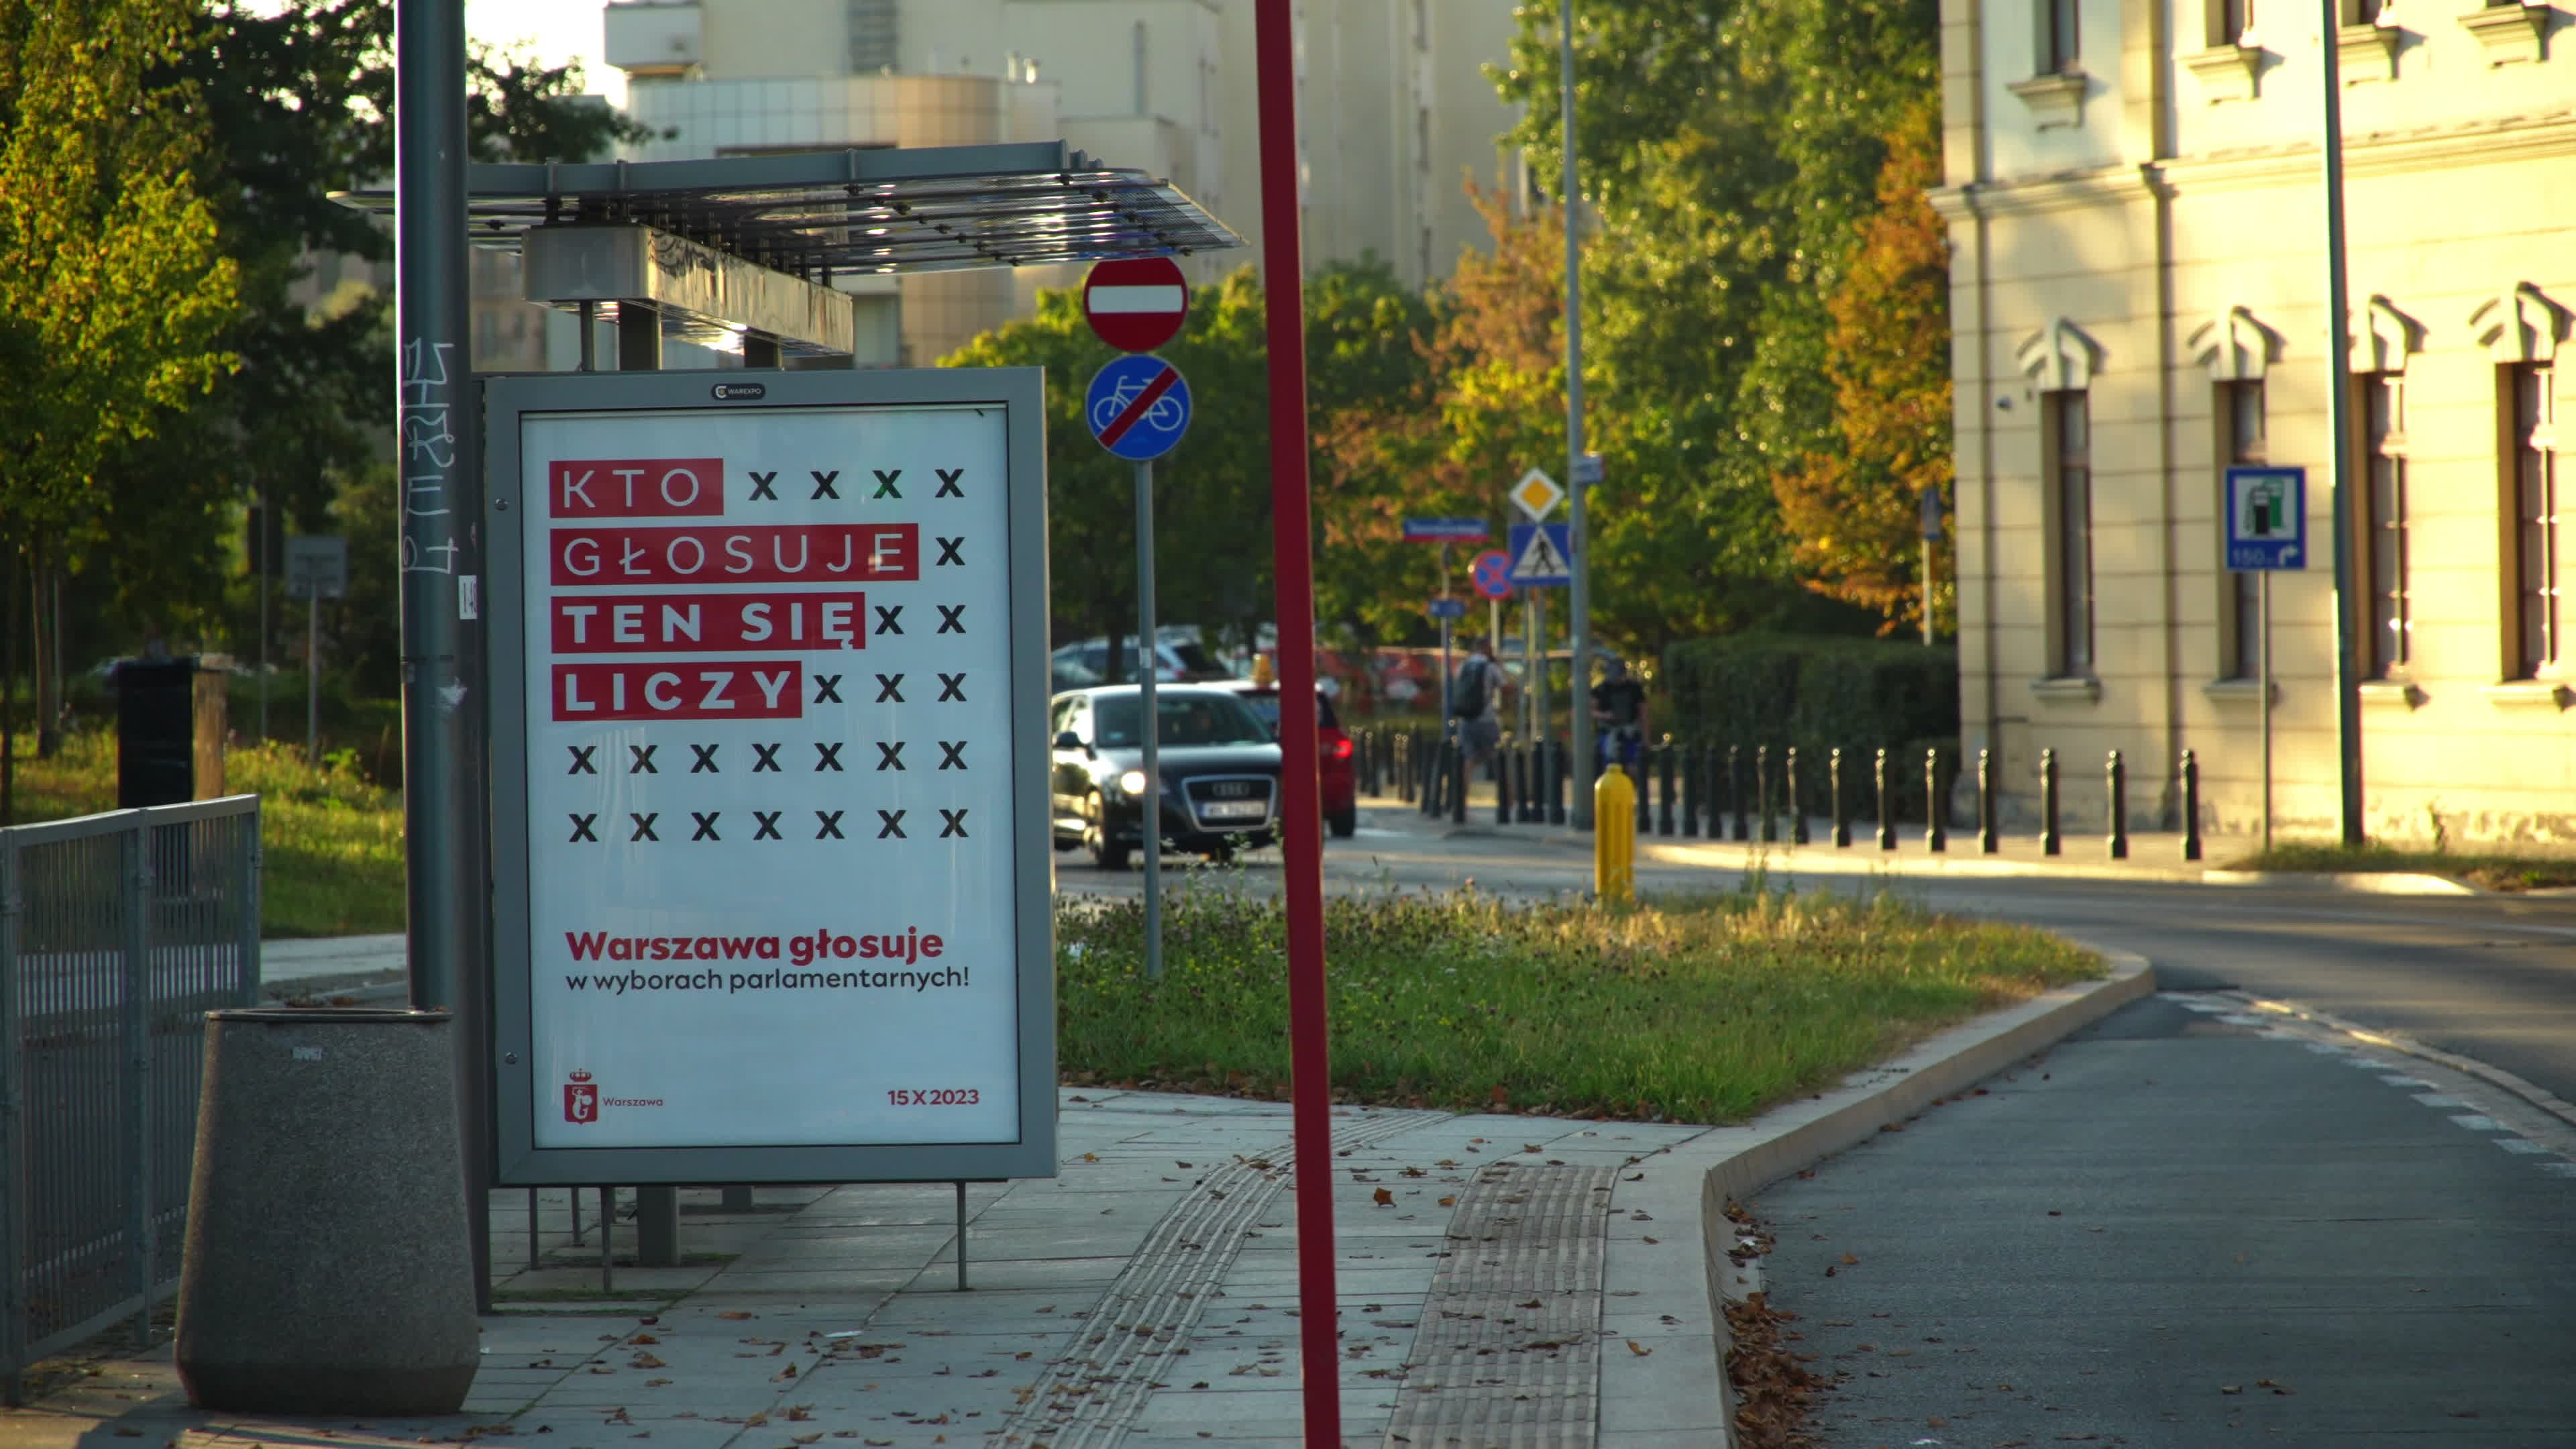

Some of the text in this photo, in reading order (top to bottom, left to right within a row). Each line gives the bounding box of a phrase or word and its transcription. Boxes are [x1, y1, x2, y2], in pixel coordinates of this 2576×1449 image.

[563, 468, 700, 509] KTO
[563, 532, 905, 577] GŁOSUJE
[561, 603, 701, 644] TEN
[739, 601, 855, 650] SIĘ
[565, 669, 792, 712] LICZY
[564, 925, 945, 967] Warszawa głosuje
[565, 965, 969, 996] w wyborach parlamentarnych!
[602, 1096, 664, 1107] Warszawa
